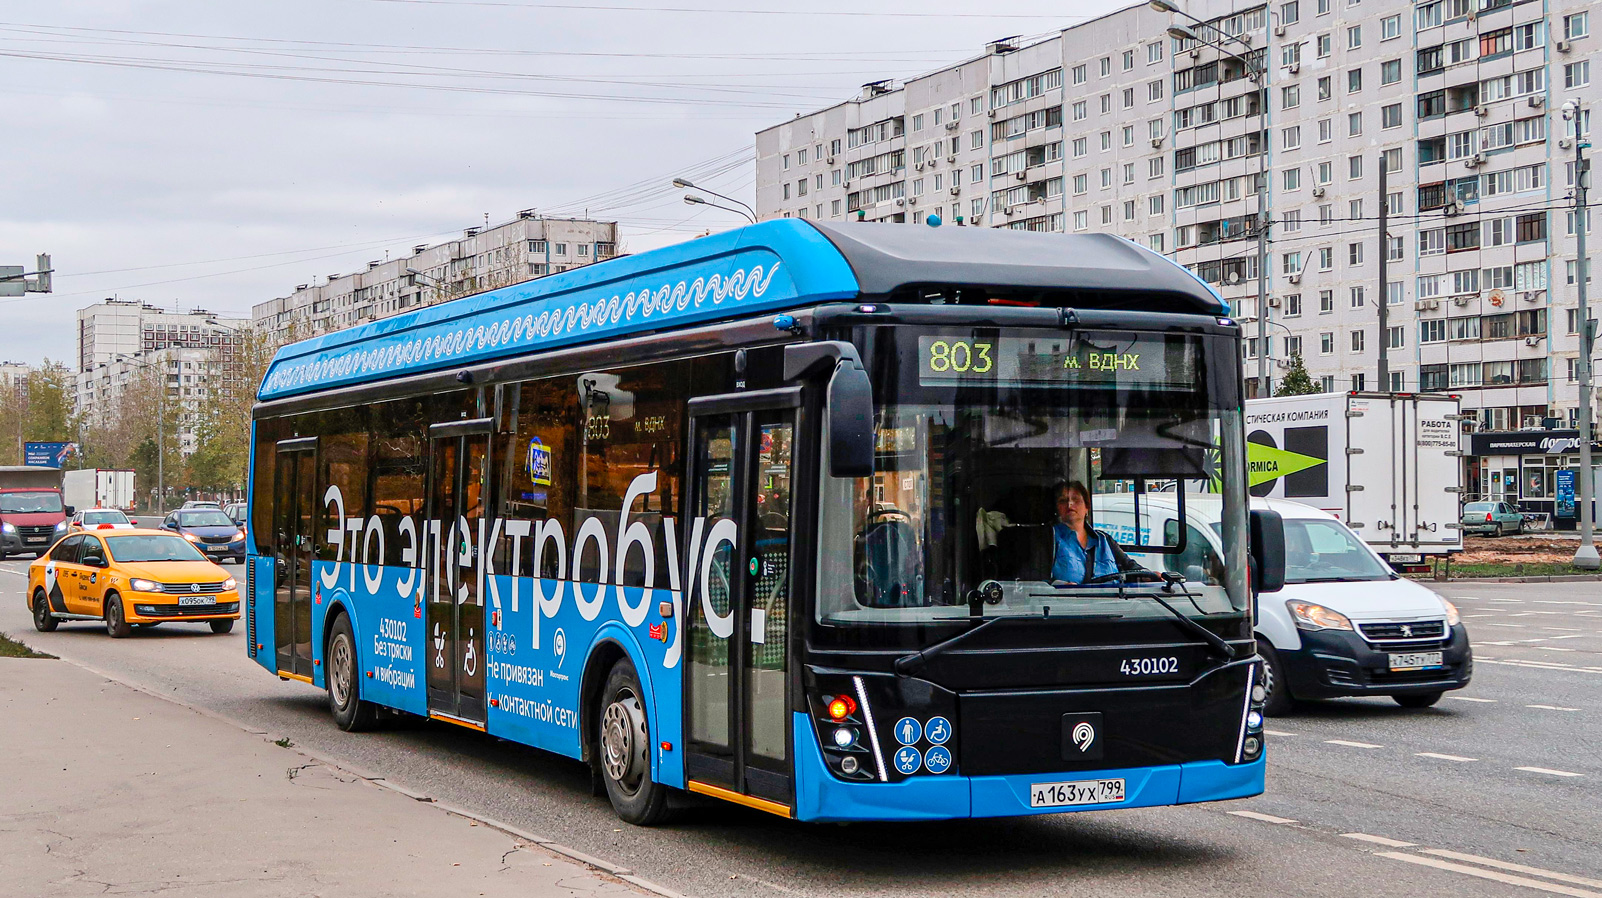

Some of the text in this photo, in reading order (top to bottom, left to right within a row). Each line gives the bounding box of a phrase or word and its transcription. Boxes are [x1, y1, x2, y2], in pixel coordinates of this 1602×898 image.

[929, 340, 1140, 373] 803 м. ВДНХ
[587, 414, 611, 440] 803
[644, 415, 666, 433] ВДНХ
[1246, 409, 1329, 425] СТИЧЕСКАЯ КОМПАНИЯ
[1421, 420, 1452, 428] РАБОТА
[1247, 460, 1278, 473] RMICA
[320, 484, 386, 595] Это
[379, 617, 408, 642] 430102
[374, 634, 413, 662] Без тряски
[374, 664, 416, 691] и вибраций
[486, 653, 544, 688] Не привязан
[1119, 656, 1179, 676] 430102
[498, 693, 553, 724] контактной
[554, 706, 578, 730] сети
[1036, 780, 1121, 804] А163УХ 799
